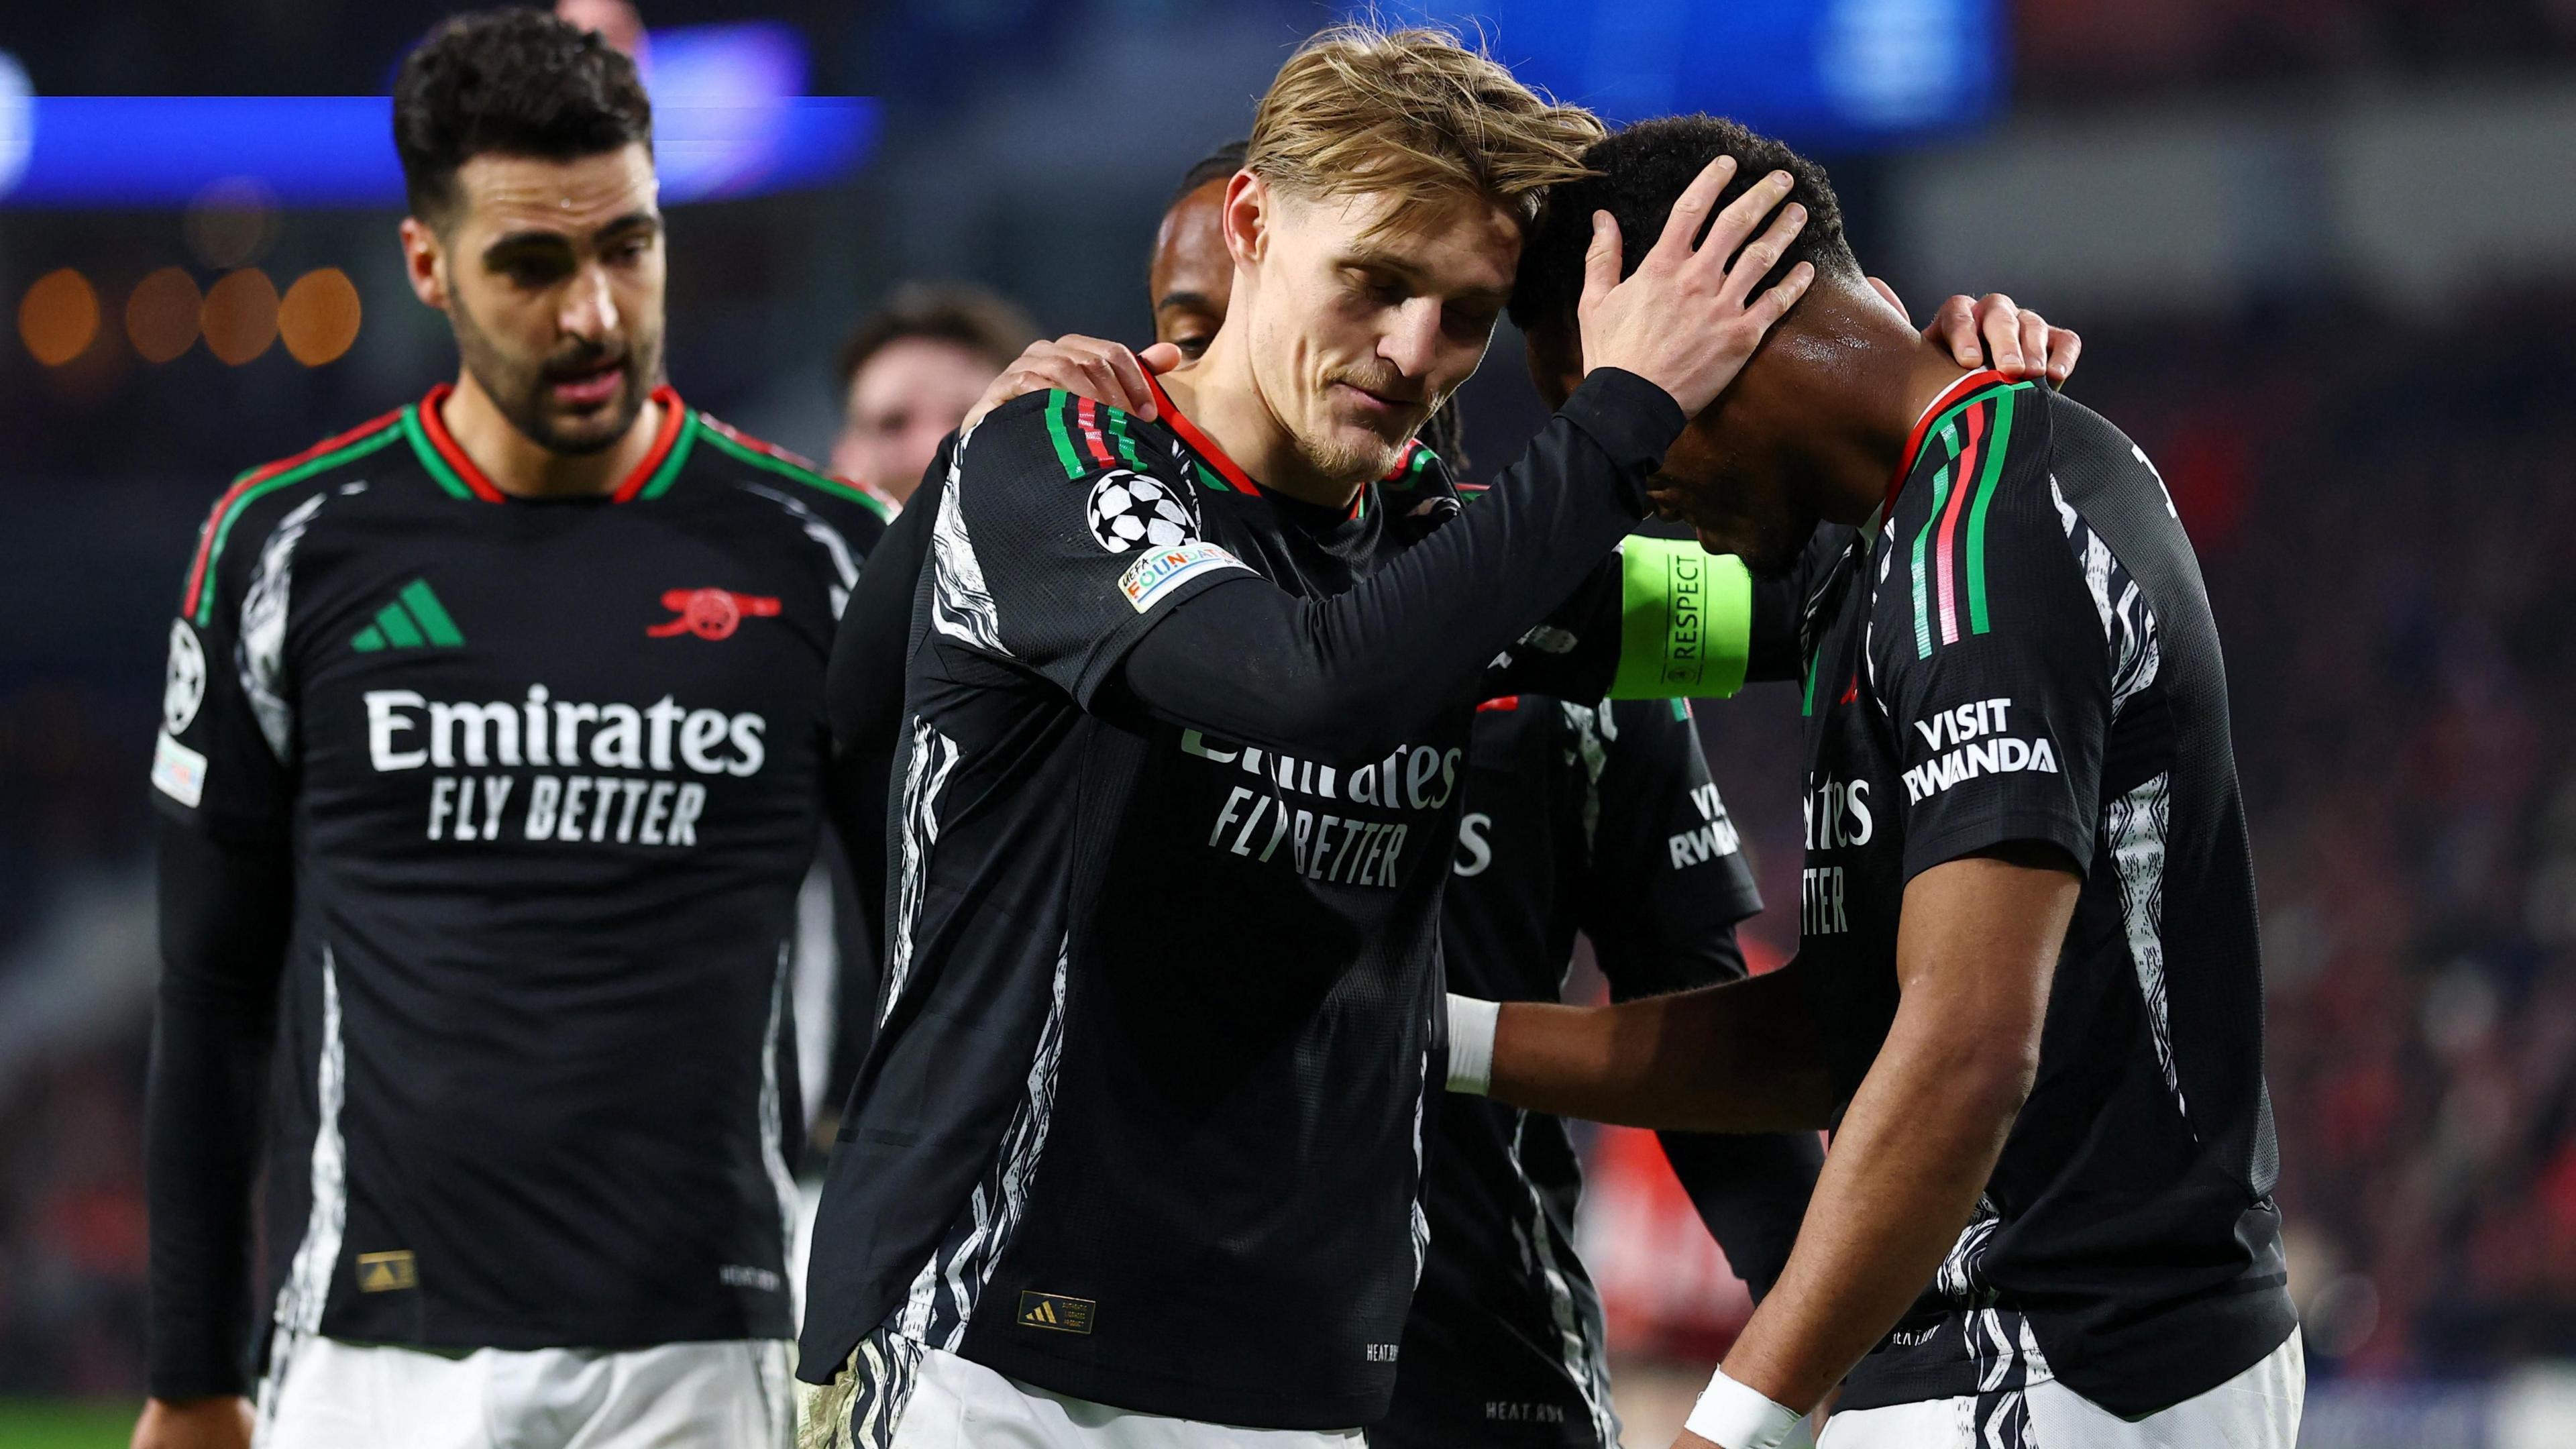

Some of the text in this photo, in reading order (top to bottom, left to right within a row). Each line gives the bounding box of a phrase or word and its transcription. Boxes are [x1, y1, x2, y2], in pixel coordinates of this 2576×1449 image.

[1122, 558, 1149, 587] UEFA
[1674, 555, 1699, 660] RESPECT
[364, 683, 766, 777] Emirates
[1913, 698, 2011, 751] VISIT
[1901, 737, 2059, 806] RWANDA
[427, 775, 706, 846] FLY BETTER
[1208, 786, 1289, 863] FLY
[1294, 809, 1408, 888] BETTER
